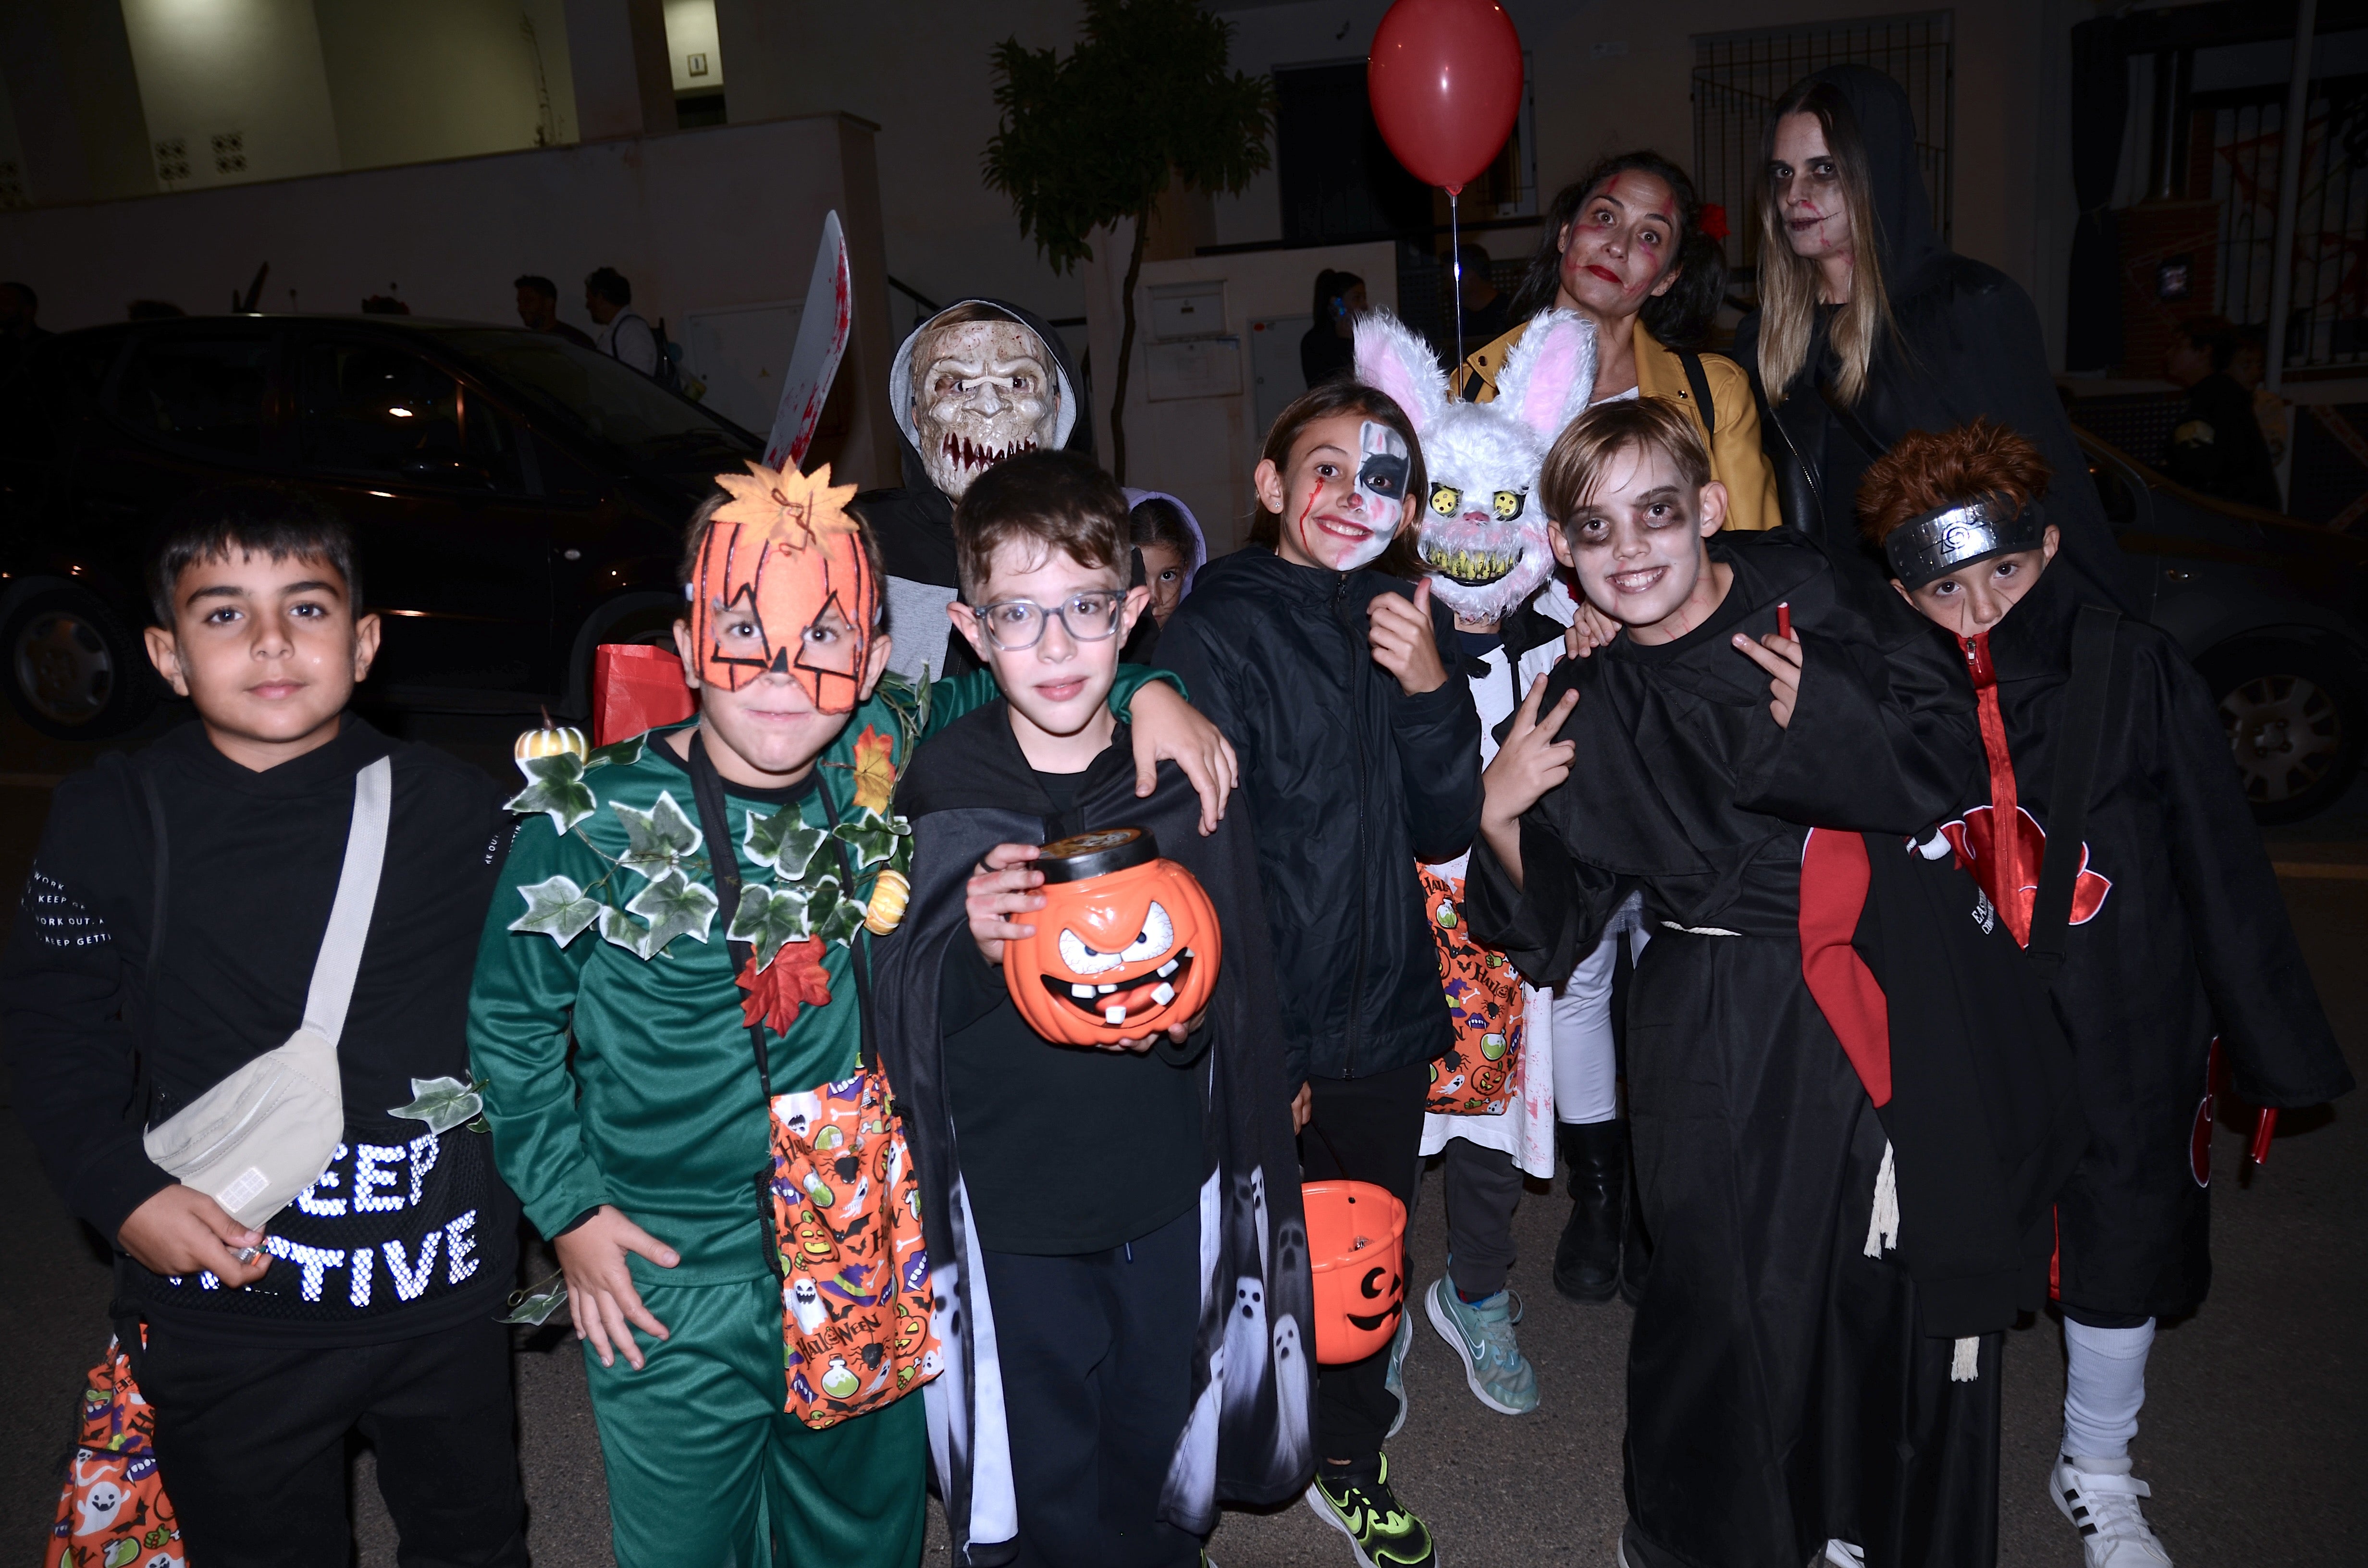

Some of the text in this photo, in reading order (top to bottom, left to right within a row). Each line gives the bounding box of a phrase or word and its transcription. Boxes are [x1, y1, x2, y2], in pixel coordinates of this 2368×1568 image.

[34, 871, 64, 891] WORK
[38, 895, 67, 903] KEEP
[45, 936, 70, 946] KEEP
[287, 1134, 439, 1217] EEP
